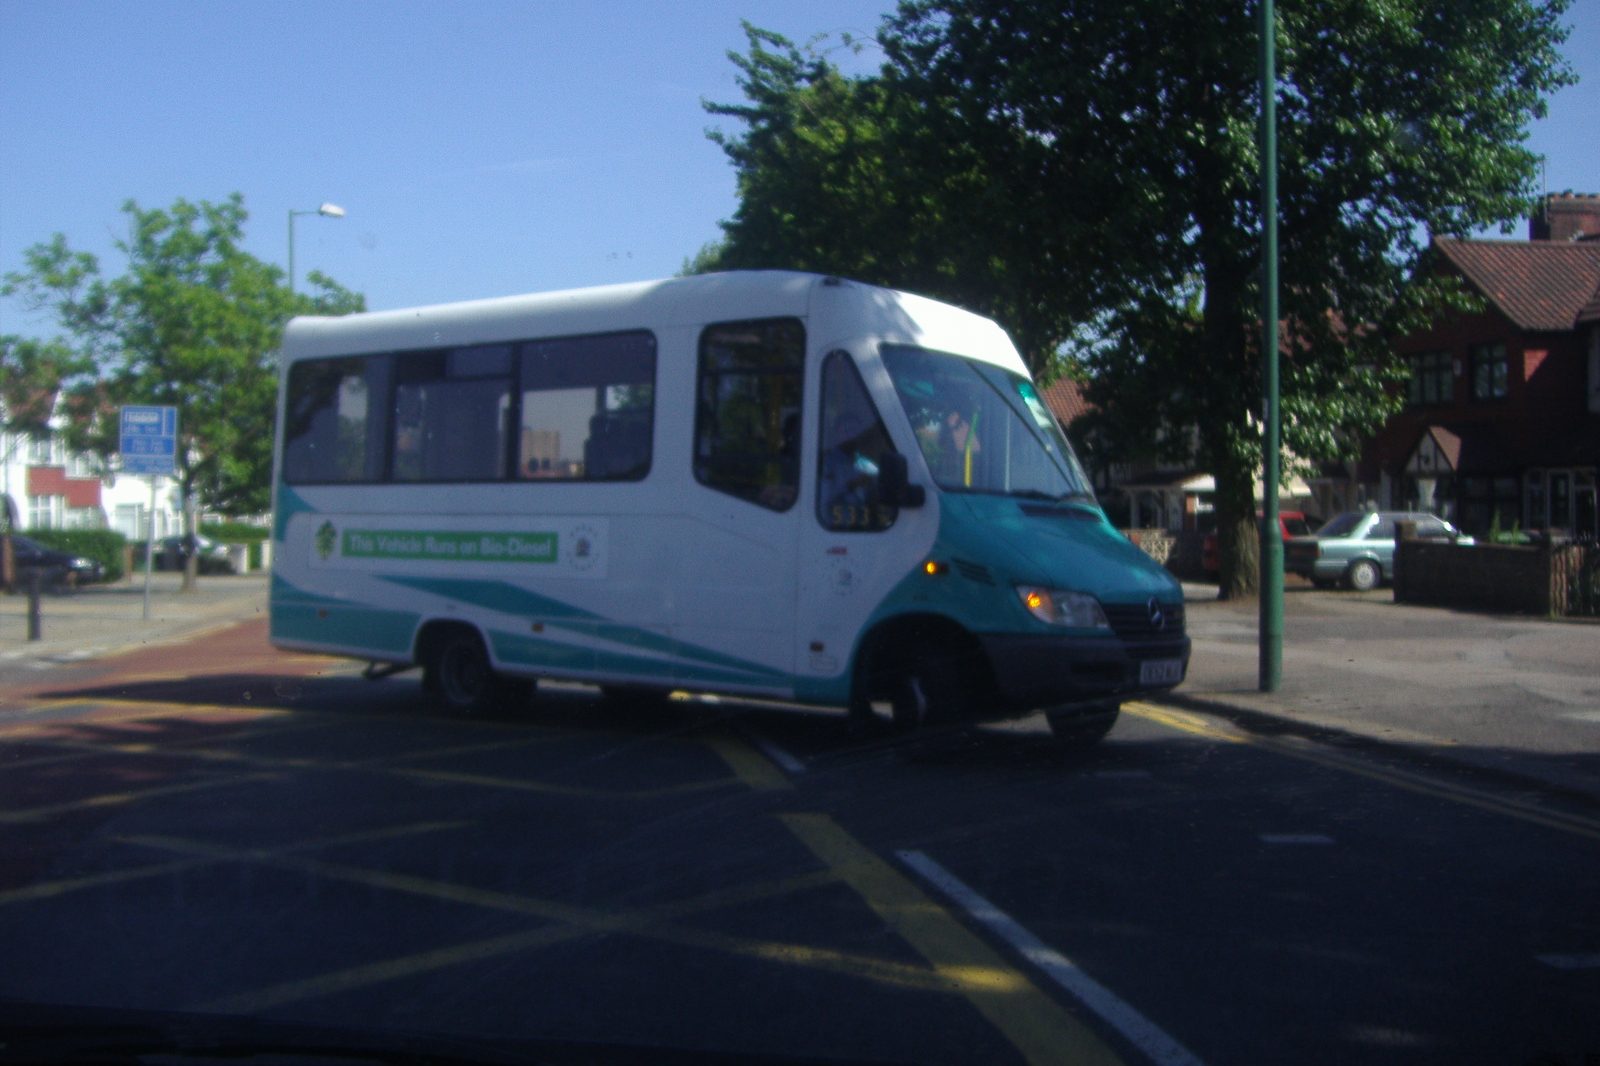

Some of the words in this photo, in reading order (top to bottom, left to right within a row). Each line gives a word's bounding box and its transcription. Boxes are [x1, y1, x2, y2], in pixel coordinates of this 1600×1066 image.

[378, 535, 422, 553] Vehicle
[424, 536, 457, 554] Runs
[459, 541, 477, 555] on
[480, 537, 551, 557] Bio-Diesel
